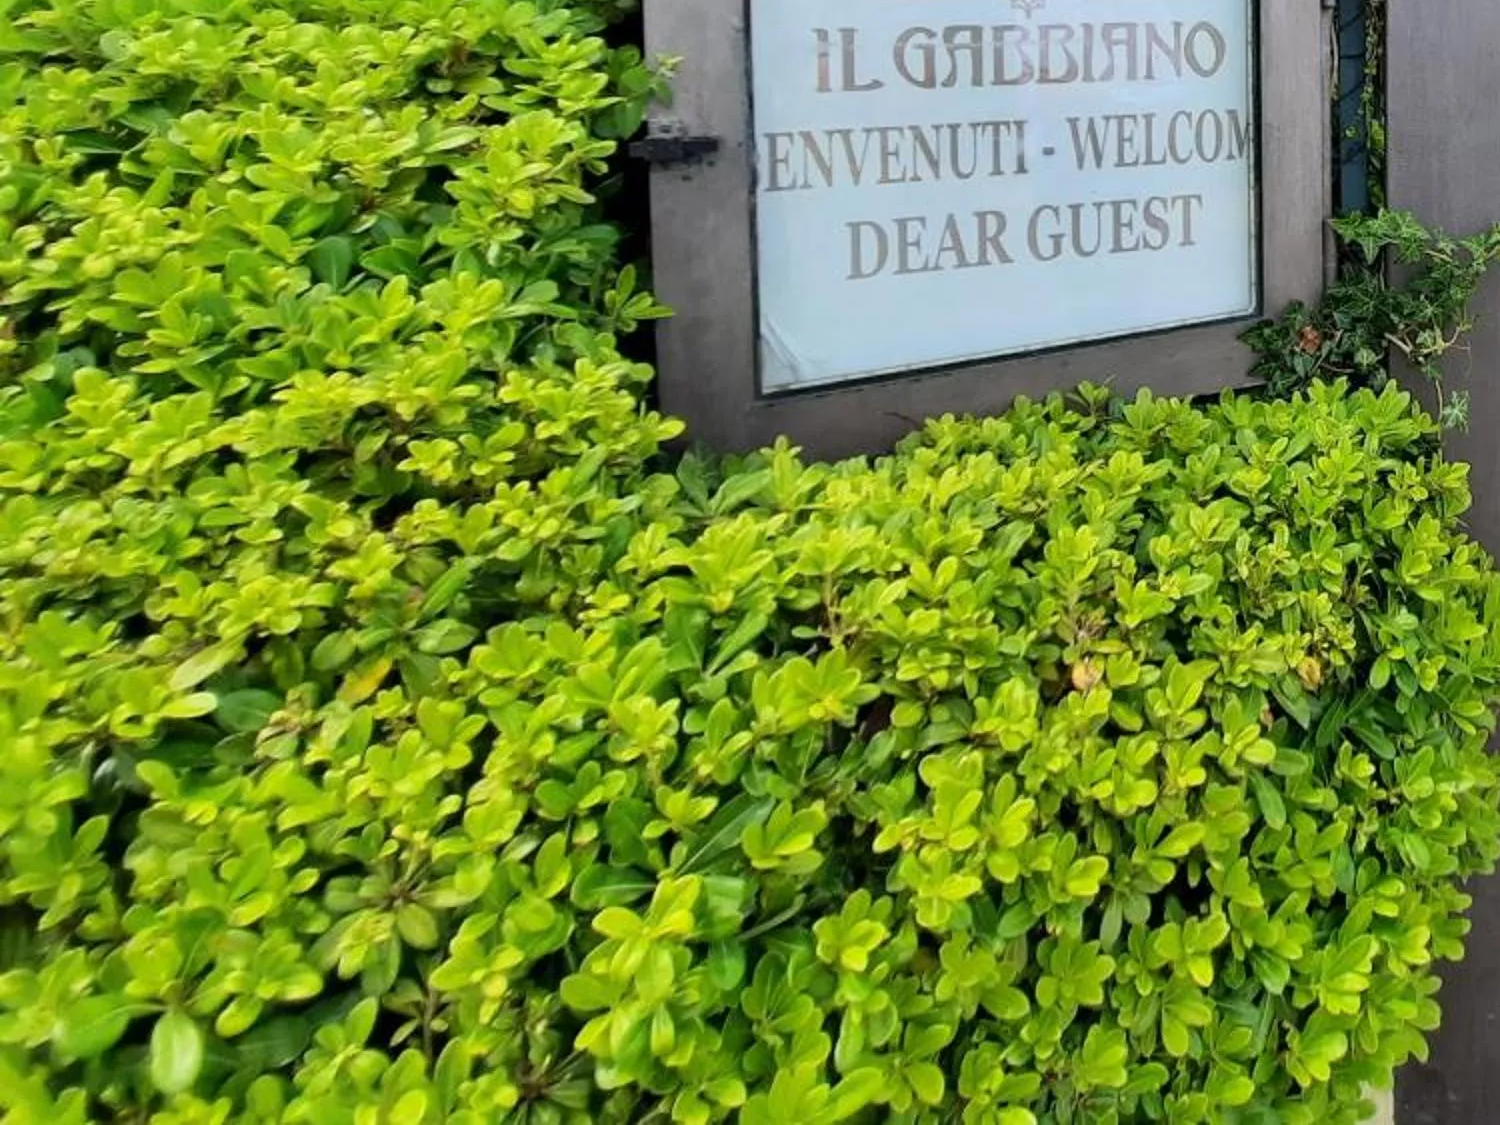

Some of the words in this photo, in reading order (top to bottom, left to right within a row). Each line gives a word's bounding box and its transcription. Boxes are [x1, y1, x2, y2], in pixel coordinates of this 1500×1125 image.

[893, 19, 1227, 89] GABBIANO
[845, 209, 1015, 281] DEAR
[1026, 193, 1203, 262] GUEST
